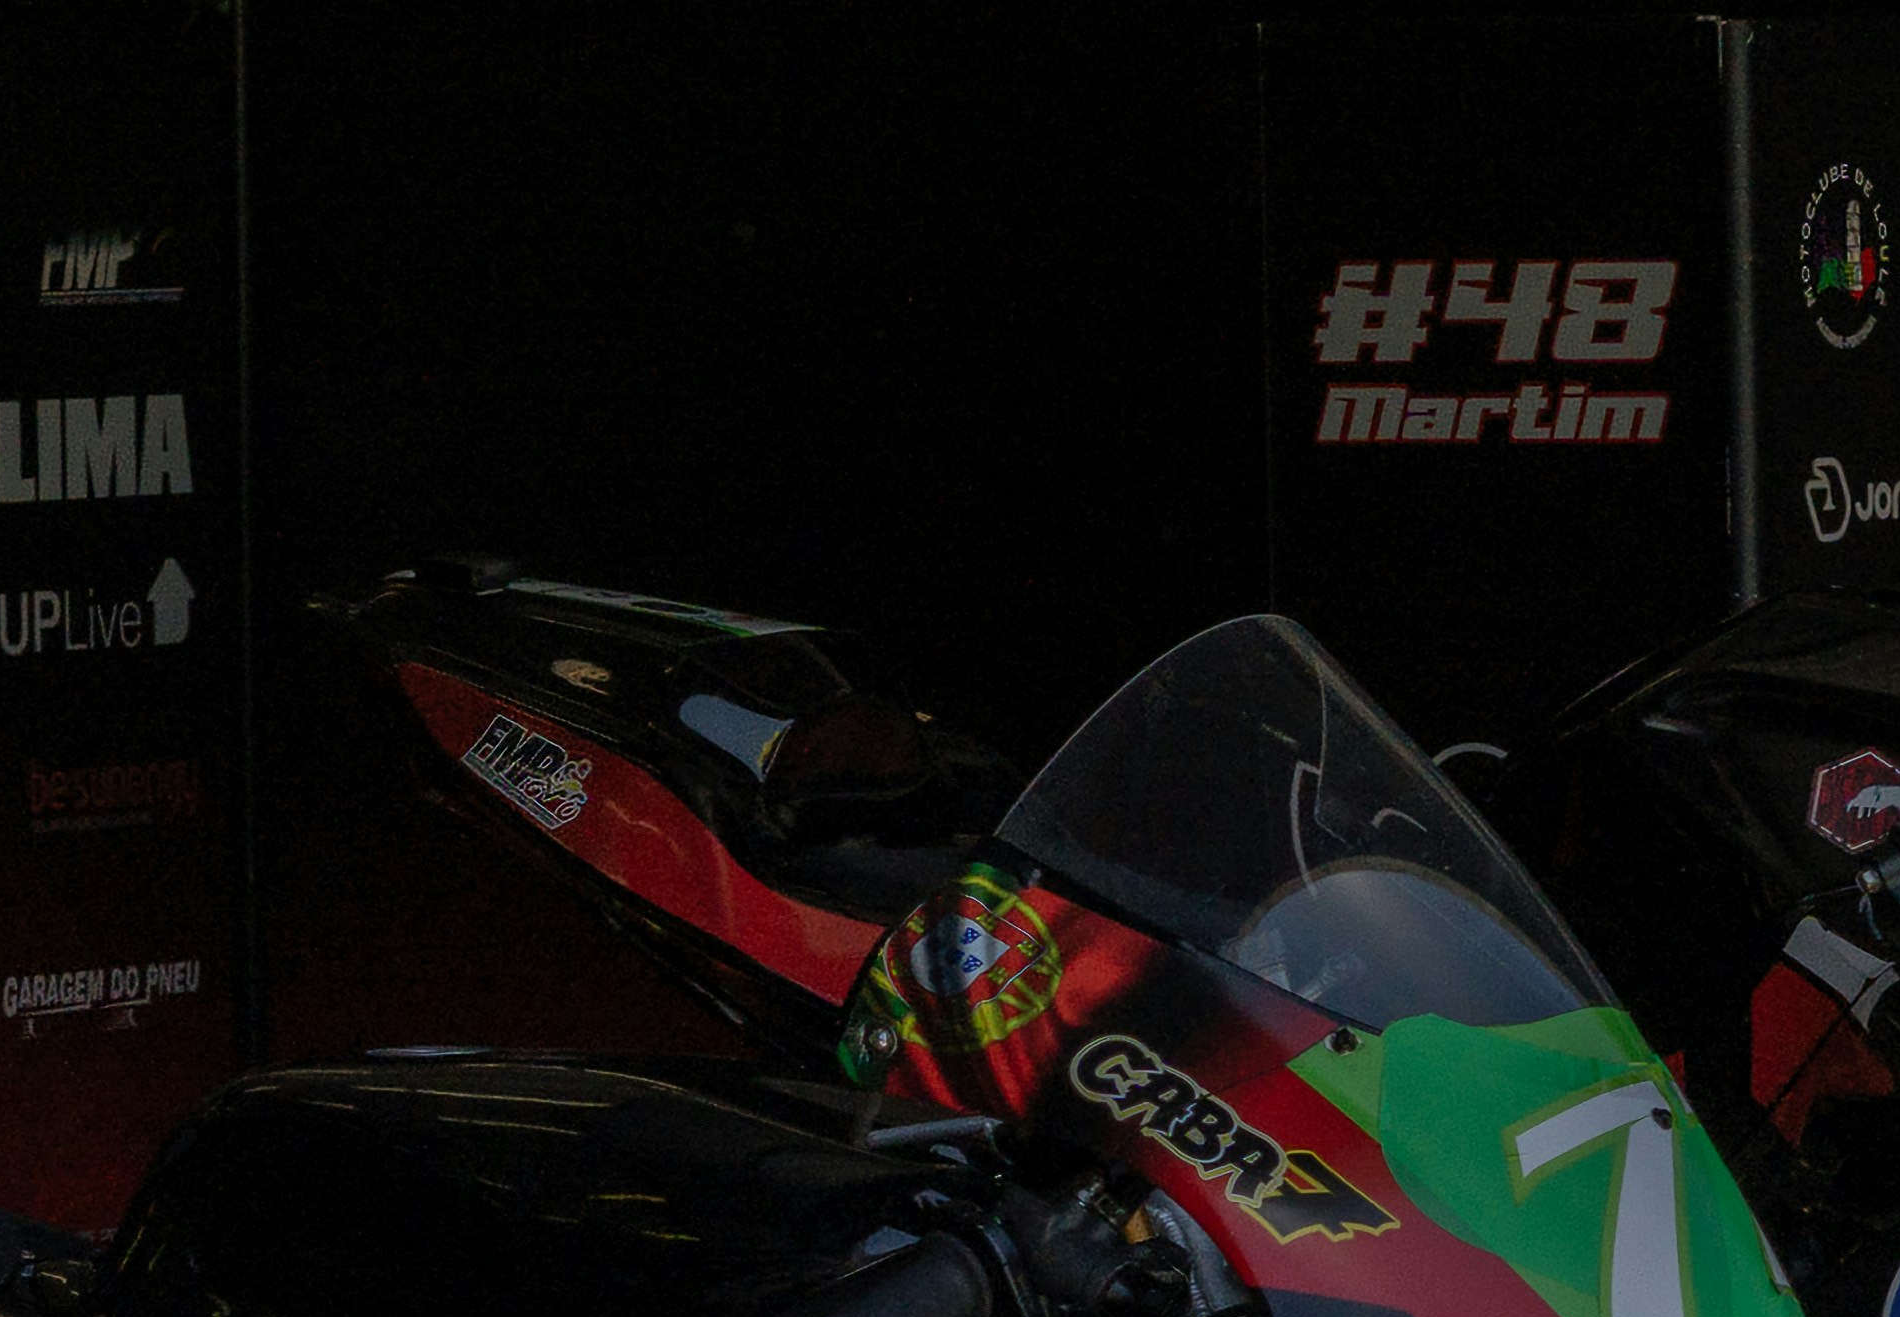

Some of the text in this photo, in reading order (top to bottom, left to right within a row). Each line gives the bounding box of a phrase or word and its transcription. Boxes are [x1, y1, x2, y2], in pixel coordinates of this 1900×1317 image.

[1315, 259, 1681, 363] #48
[1315, 381, 1672, 444] Martim
[0, 589, 144, 657] UPLive
[2, 959, 201, 1018] GARAGEM DO PNEU
